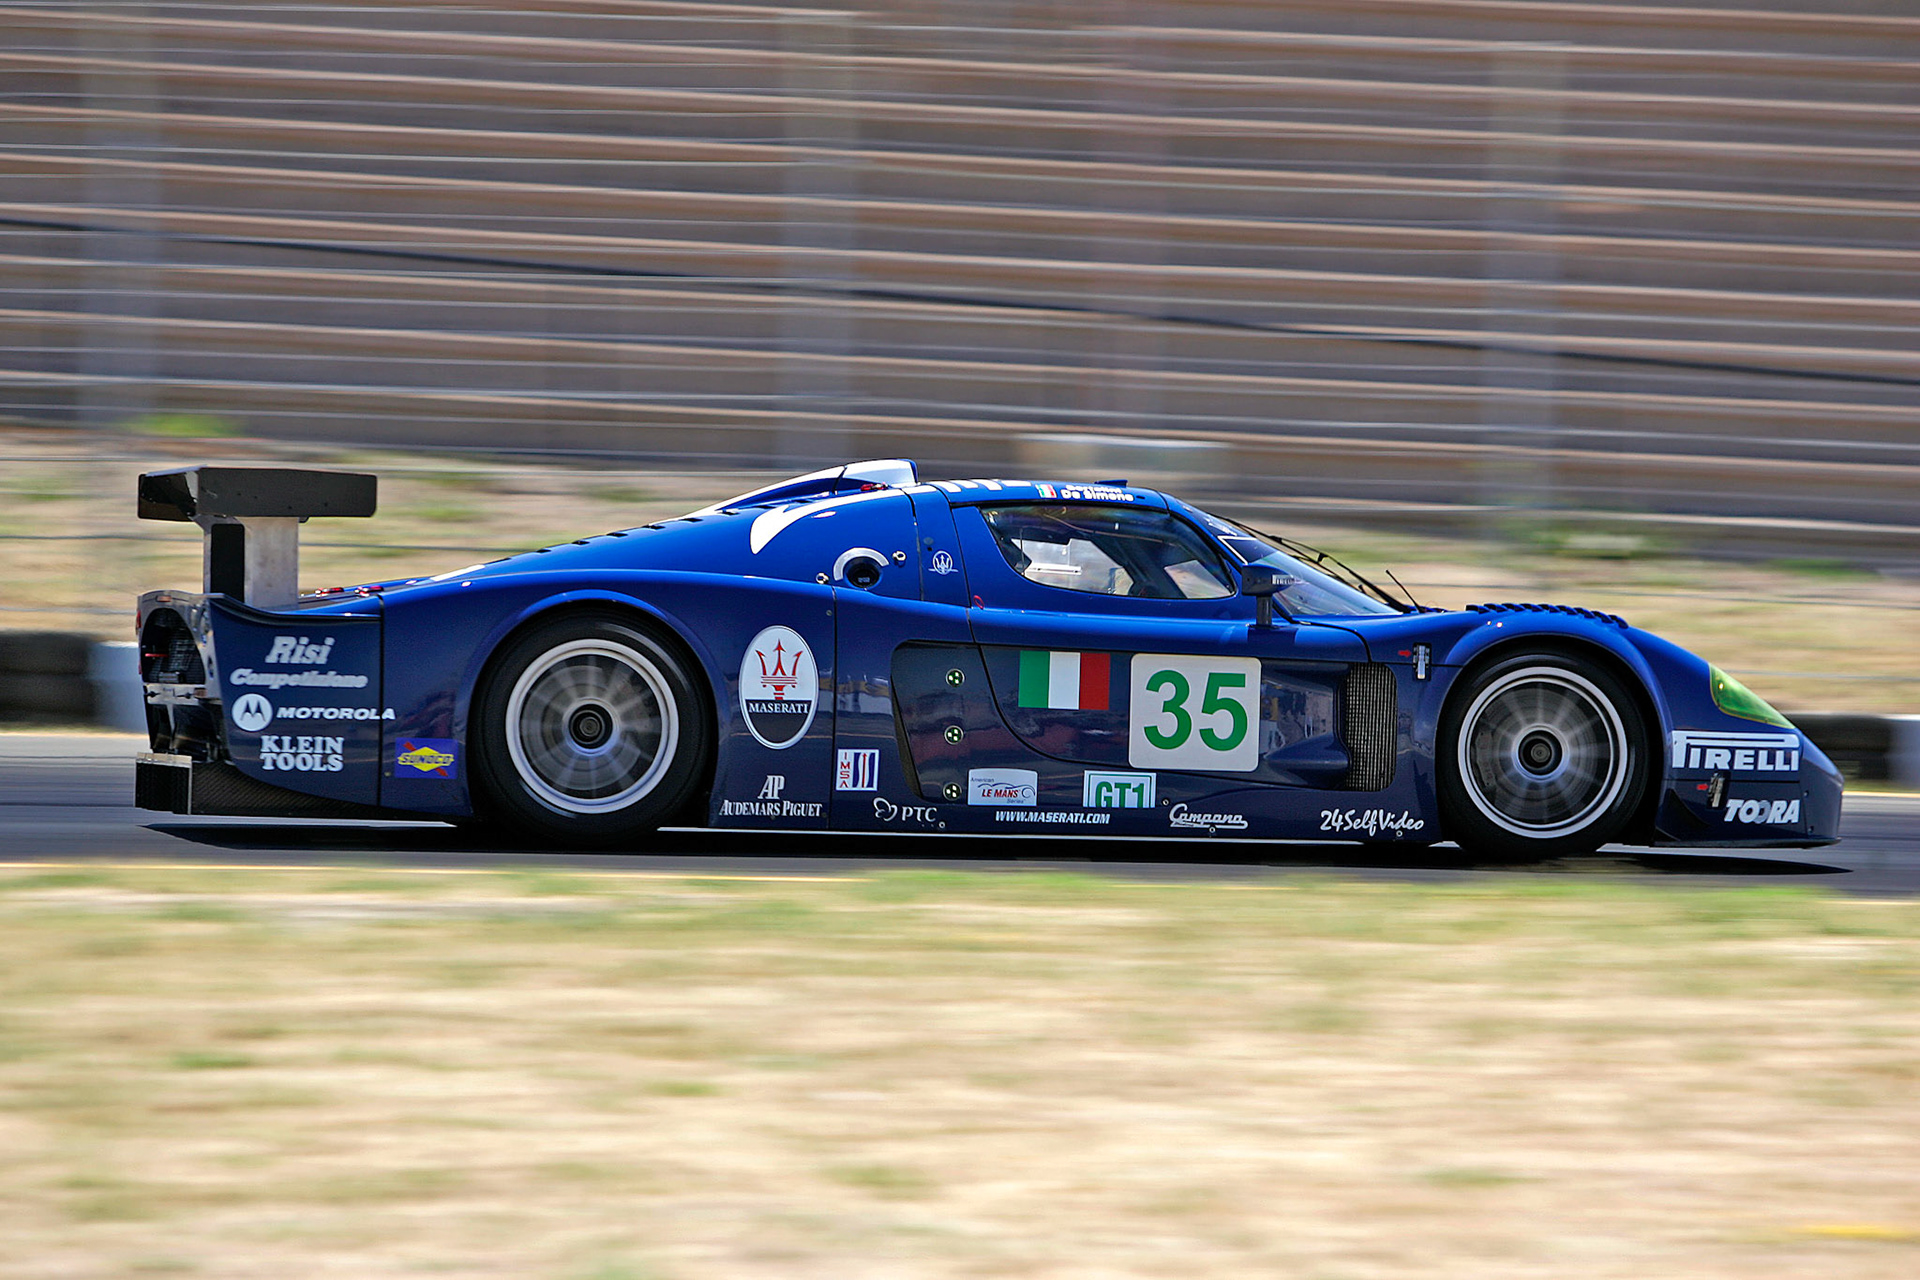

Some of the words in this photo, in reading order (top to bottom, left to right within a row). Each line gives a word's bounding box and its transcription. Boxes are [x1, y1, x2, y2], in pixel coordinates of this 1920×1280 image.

[265, 635, 335, 665] Risi
[230, 667, 368, 690] Competizione
[276, 706, 396, 720] MOTOROLA
[748, 702, 810, 714] MASERATI
[1143, 669, 1248, 751] 35
[260, 735, 344, 754] KLEIN
[1671, 730, 1800, 771] PIRELLI
[259, 752, 344, 772] TOOLS
[399, 754, 454, 765] SUNOCO
[839, 752, 851, 788] IMSA
[981, 788, 992, 798] LE
[994, 788, 1019, 799] MANS
[1095, 781, 1145, 809] GT1
[718, 799, 781, 818] AUDEMARS
[783, 800, 823, 818] PIGUET
[901, 806, 938, 823] PTC
[995, 810, 1111, 825] WWW.MASERATI.COM
[1723, 799, 1800, 825] TOORA
